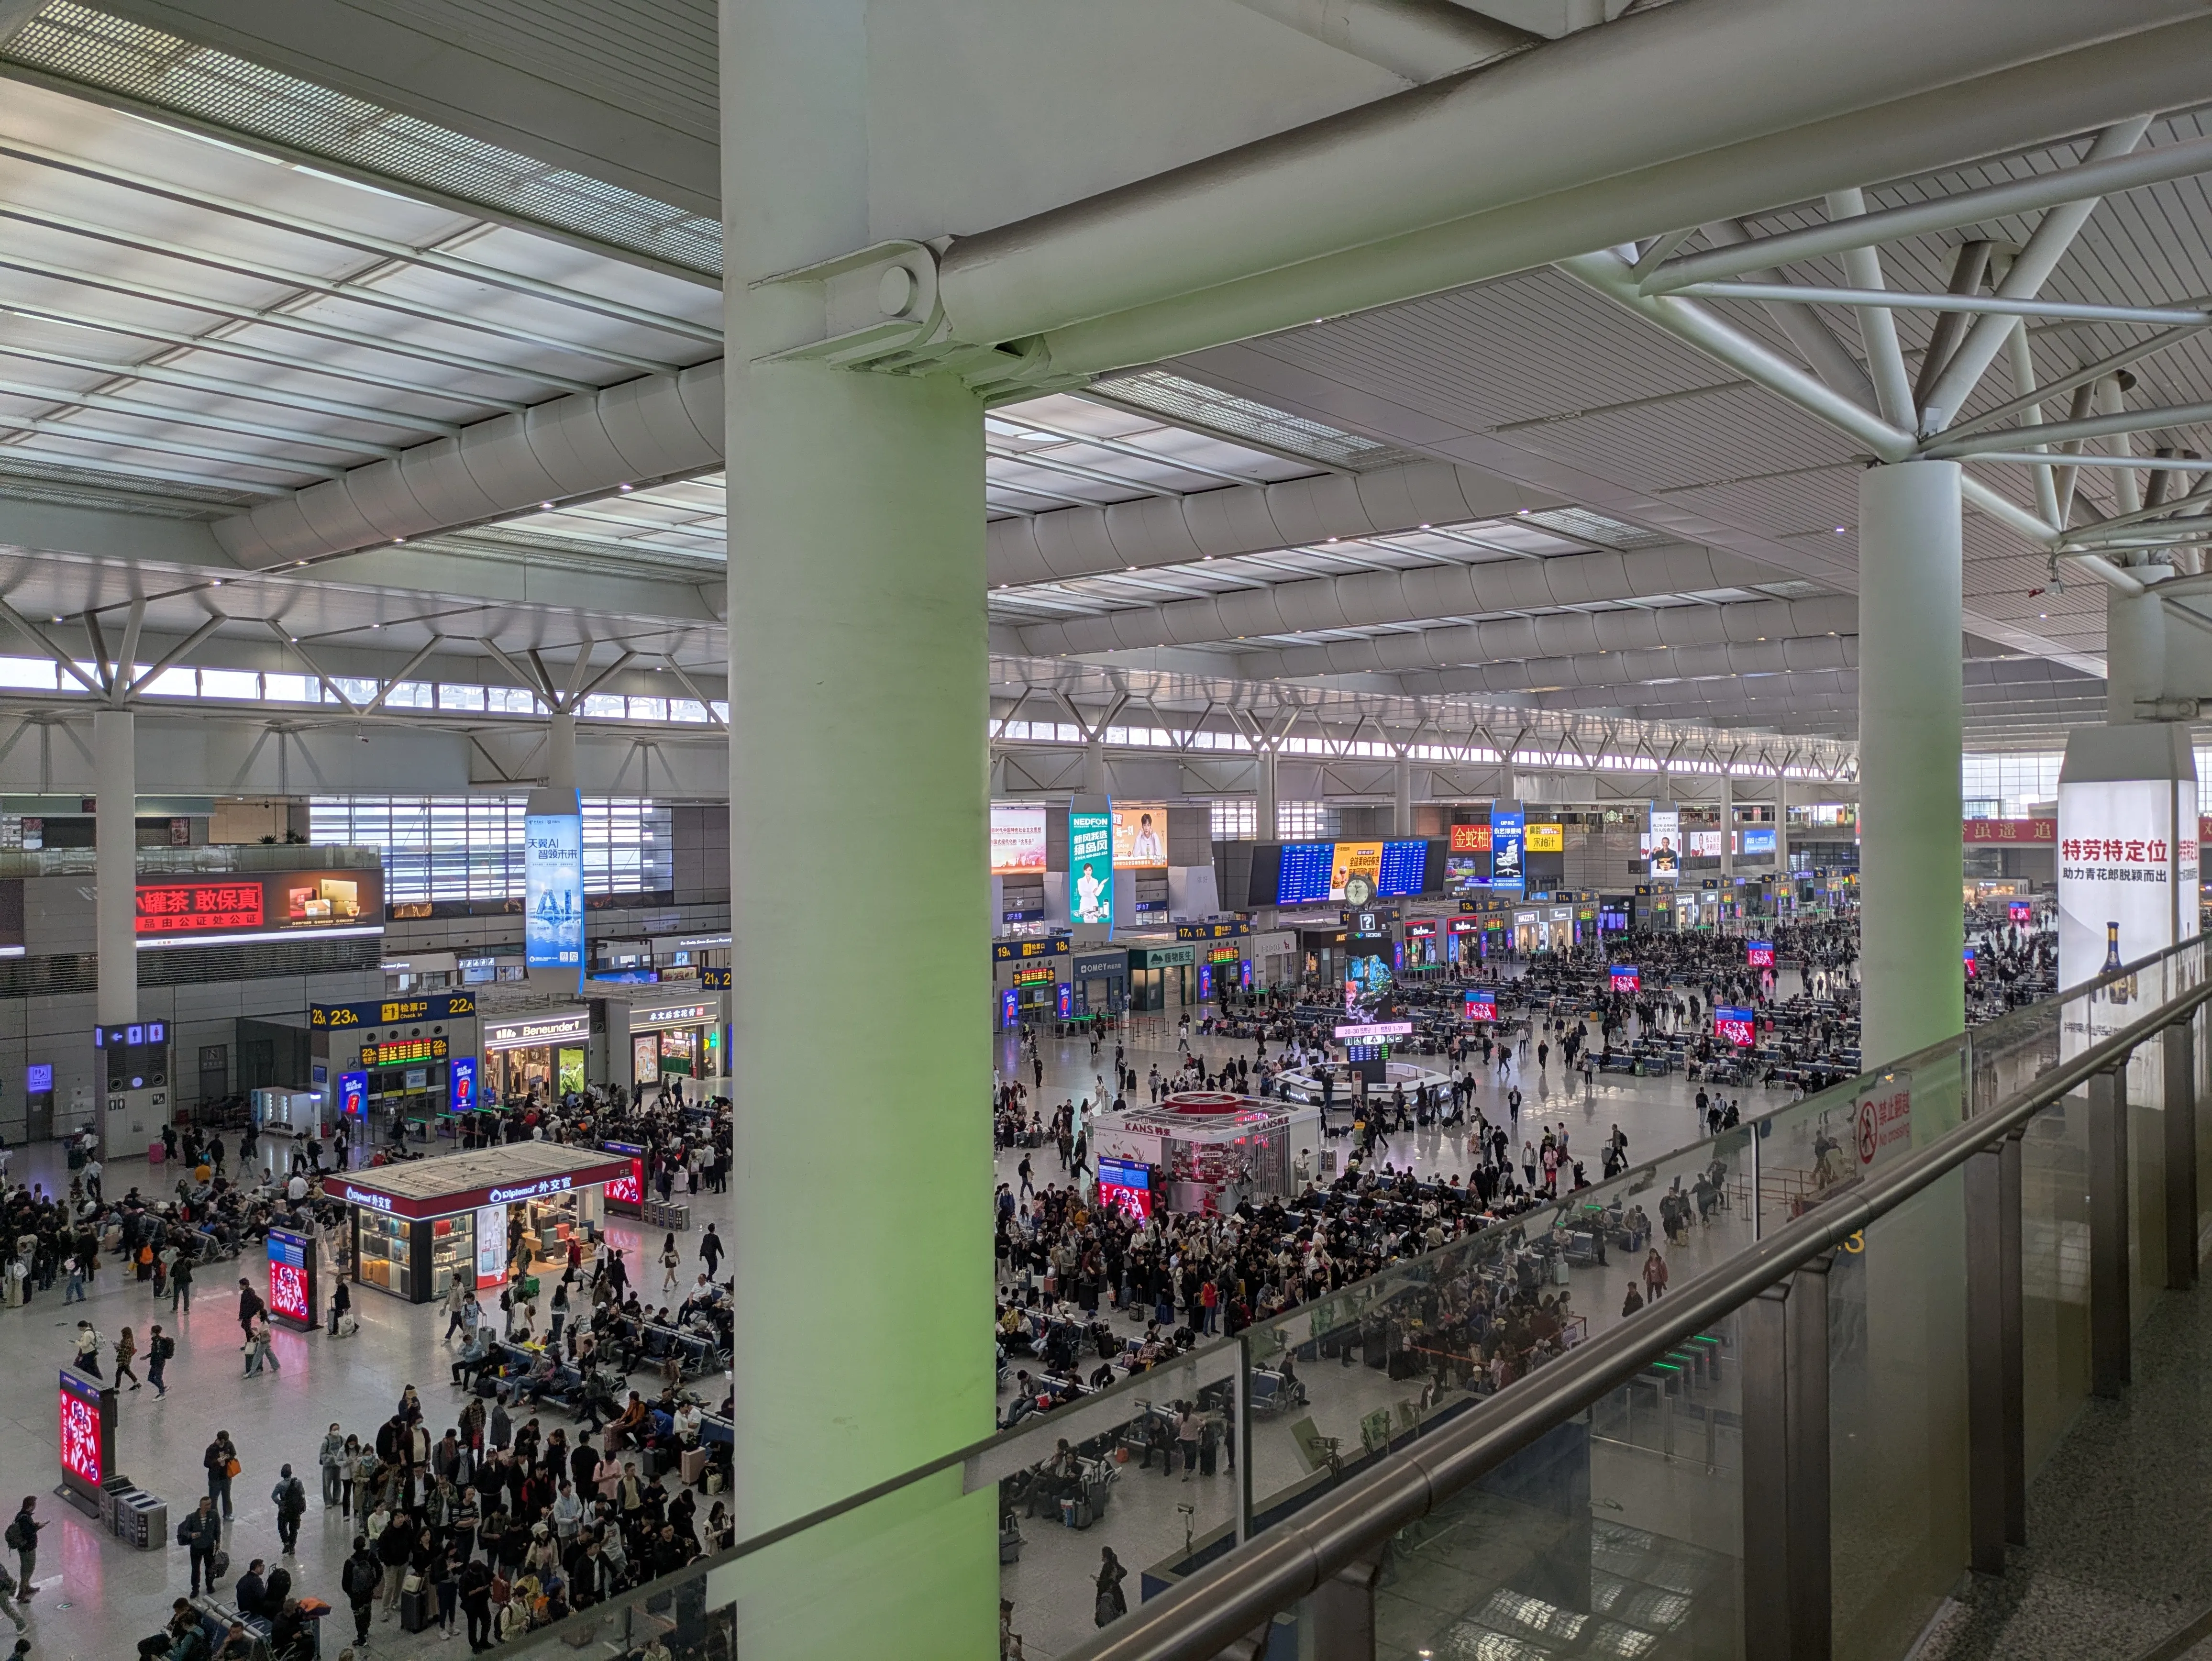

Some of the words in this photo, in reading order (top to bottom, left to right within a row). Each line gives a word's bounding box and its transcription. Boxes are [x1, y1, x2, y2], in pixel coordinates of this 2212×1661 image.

[1074, 830, 1108, 844] 新风我选
[2034, 822, 2052, 839] 追
[528, 838, 559, 849] 天翼AI
[1074, 839, 1108, 856] 绿岛风
[1533, 837, 1556, 847] 宋柚汁
[538, 849, 577, 859] 智领未来
[2062, 839, 2168, 863] 特劳特定位
[2062, 867, 2167, 883] 助力青花郎脱颖而出
[195, 888, 258, 911] 敢保真
[144, 914, 256, 928] 品由公证处公证
[1518, 914, 1535, 923] HAZZYS
[1179, 928, 1192, 938] 17A
[1196, 928, 1206, 937] 17A
[1239, 924, 1249, 933] 16A
[997, 947, 1011, 957] 19A
[1056, 941, 1068, 952] 18A
[1261, 943, 1281, 952] ERDOS
[1164, 951, 1192, 963] 植物医生
[400, 1002, 427, 1012] 检票口
[449, 998, 474, 1013] 22A
[312, 1009, 326, 1025] 23A
[331, 1009, 358, 1026] 23A
[523, 1022, 574, 1036] Beneunder
[433, 1040, 447, 1049] 22A
[362, 1048, 376, 1057] 23A
[1879, 1090, 1910, 1126] 禁止翻越
[1125, 1122, 1154, 1134] KANS
[1154, 1126, 1172, 1137] 韩束
[1255, 1118, 1277, 1132] KANS
[1278, 1116, 1290, 1126] 韩束
[503, 1185, 535, 1199] Diplomat
[539, 1176, 572, 1193] 外交官
[372, 1194, 391, 1210] 外交官
